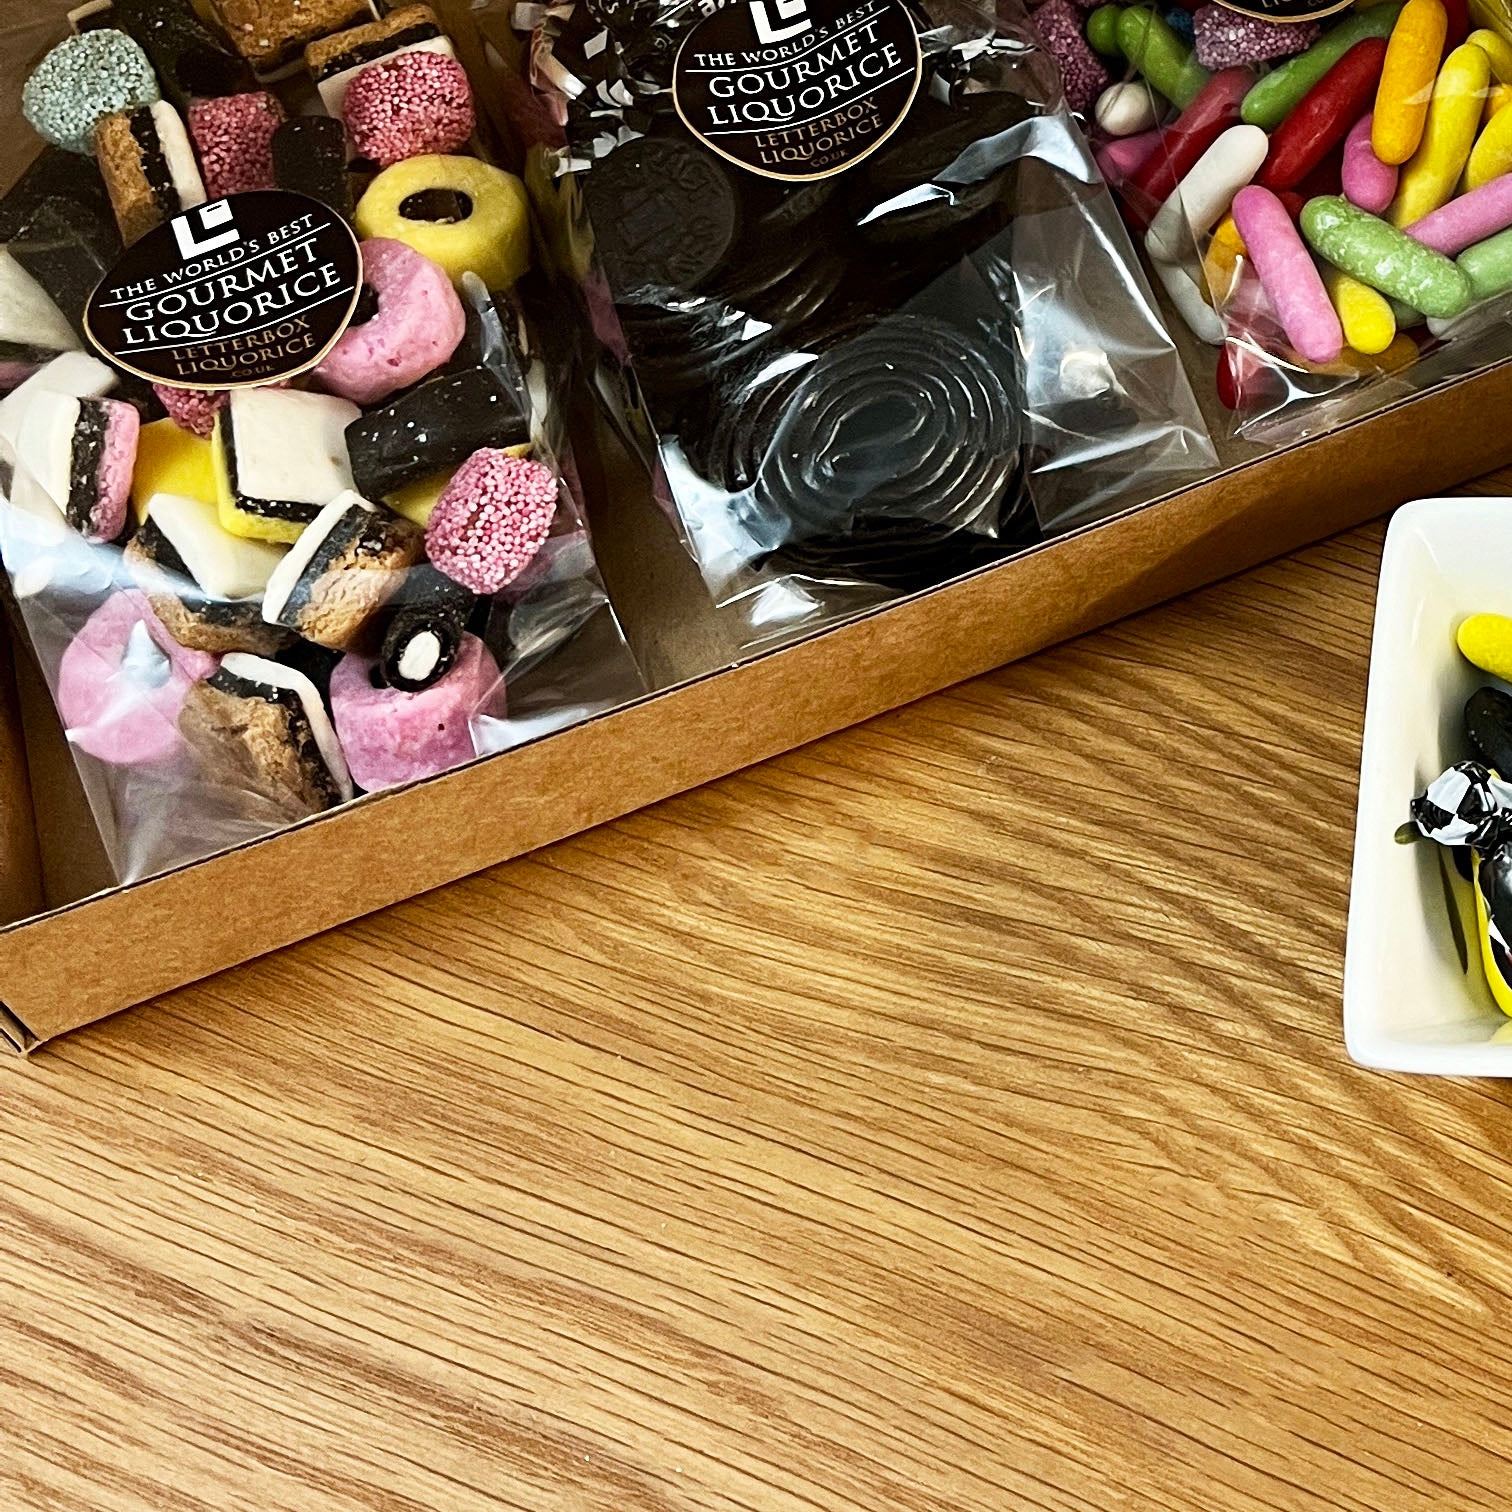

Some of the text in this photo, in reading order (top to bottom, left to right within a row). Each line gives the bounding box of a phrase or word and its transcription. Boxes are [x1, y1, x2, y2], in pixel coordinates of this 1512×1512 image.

[694, 0, 876, 68] THE WORLD'S BEST
[709, 20, 882, 99] GOURMET
[708, 42, 902, 125] LIQUORICE
[755, 97, 880, 149] LETTERBOX
[760, 113, 884, 165] LIQUORICE
[110, 213, 314, 300] THE WORLD'S BEST
[126, 238, 319, 322] GOURMET
[122, 263, 341, 345] LIQUORICE
[171, 314, 312, 361] LETTERBOX
[176, 333, 317, 376] LIQUORICE
